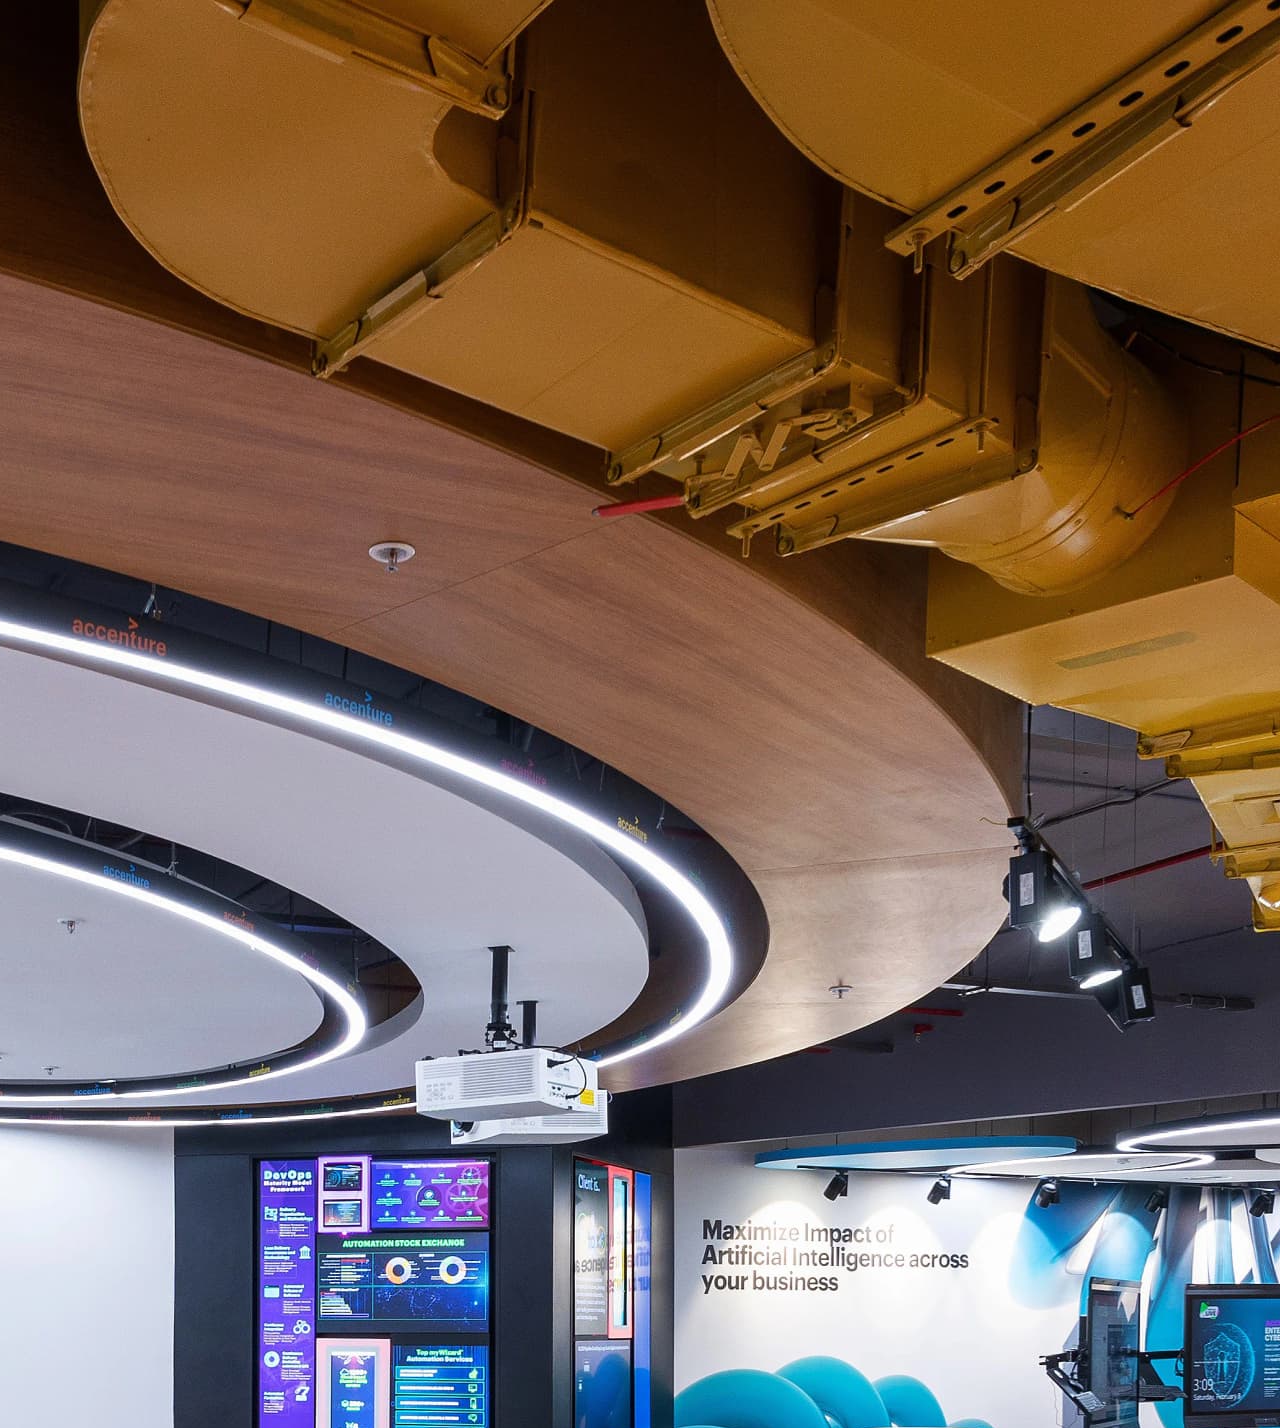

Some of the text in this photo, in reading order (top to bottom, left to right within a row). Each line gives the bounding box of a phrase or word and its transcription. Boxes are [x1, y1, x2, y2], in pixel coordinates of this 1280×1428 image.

[72, 616, 167, 658] accenture
[324, 690, 393, 728] accenture
[501, 758, 547, 786] accenture
[617, 815, 648, 844] accenture
[103, 863, 150, 890] accenture
[263, 1170, 312, 1180] DevOps
[343, 1238, 465, 1248] AUTOMATION STOCK EXCHANGE
[701, 1219, 895, 1247] Maximize Impact of
[701, 1244, 969, 1272] Artificial Intelligence across
[701, 1270, 839, 1294] your business
[1193, 1378, 1214, 1391] 3:09
